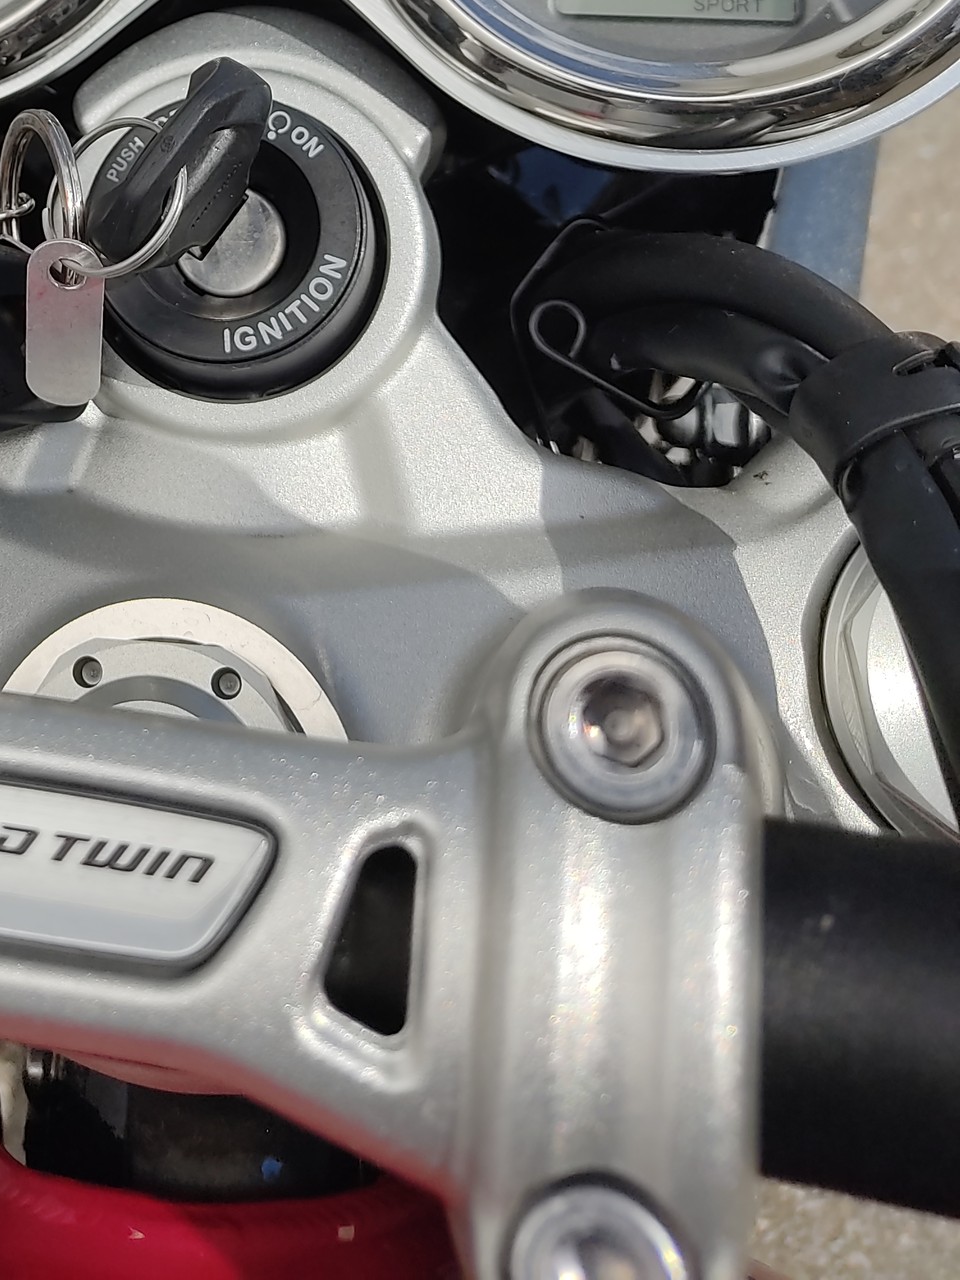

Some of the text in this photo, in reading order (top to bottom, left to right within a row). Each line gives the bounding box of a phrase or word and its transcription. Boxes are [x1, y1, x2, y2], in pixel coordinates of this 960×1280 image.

[106, 136, 145, 182] PUSH
[290, 125, 325, 159] ON
[223, 253, 348, 354] IGNITION
[50, 830, 216, 884] TWIN
